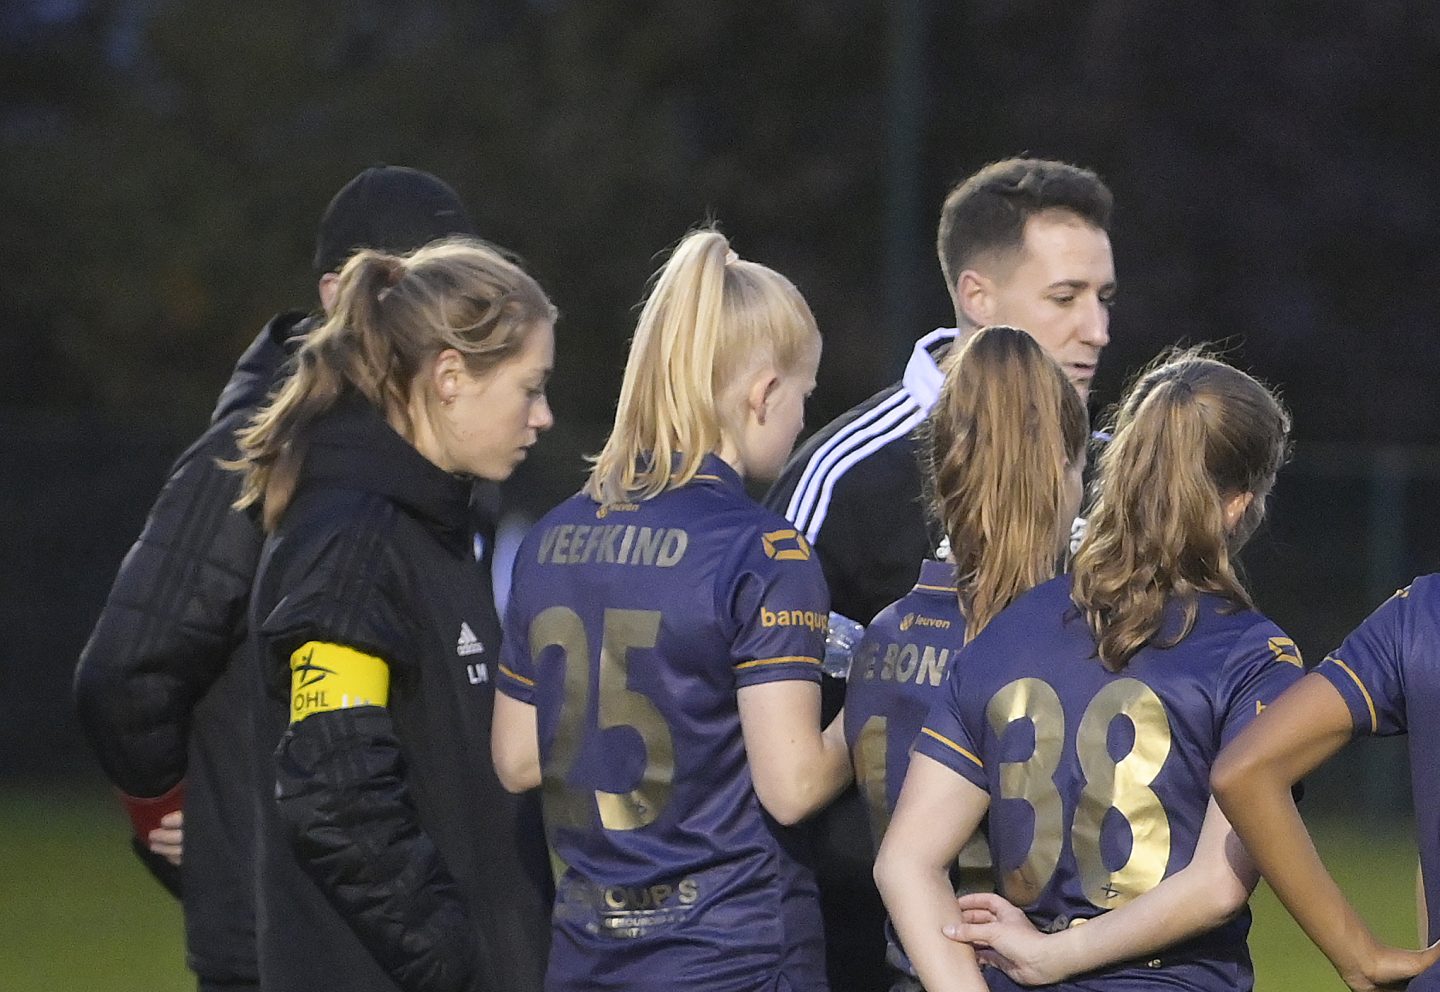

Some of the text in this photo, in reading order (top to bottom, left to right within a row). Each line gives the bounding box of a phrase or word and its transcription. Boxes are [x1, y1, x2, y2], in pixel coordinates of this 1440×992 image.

[293, 691, 328, 712] OHL
[528, 606, 675, 831] 25
[985, 677, 1171, 910] 38
